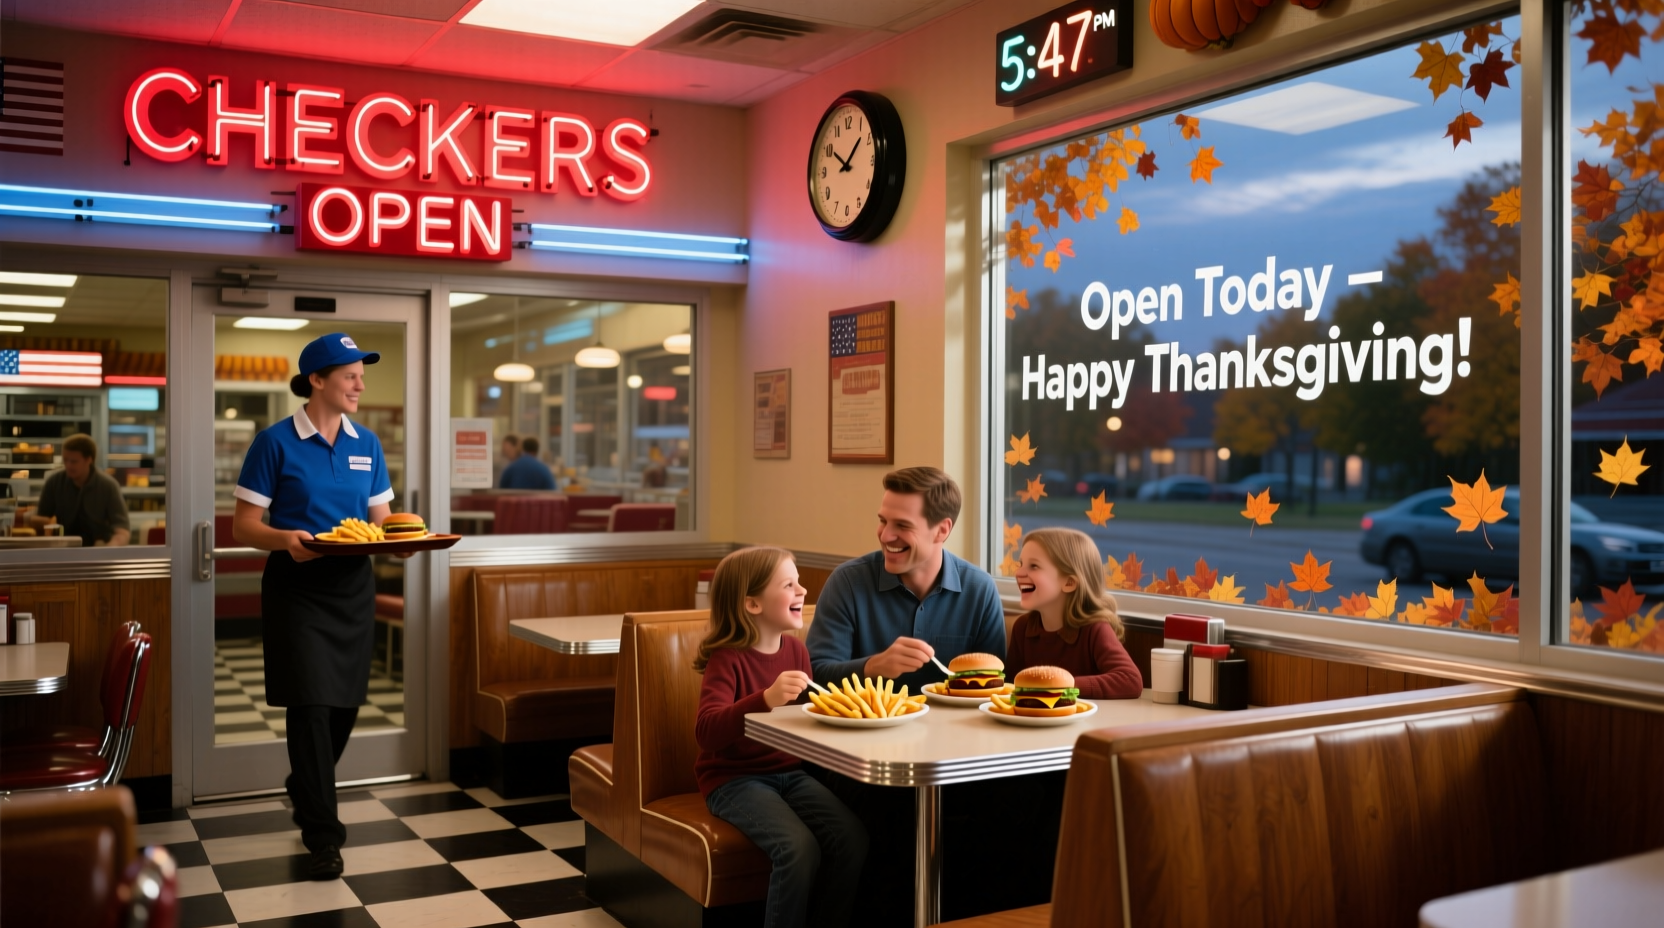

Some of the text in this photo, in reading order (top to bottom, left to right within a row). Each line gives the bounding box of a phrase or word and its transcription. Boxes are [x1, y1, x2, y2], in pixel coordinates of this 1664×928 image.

[1001, 9, 1116, 92] 5:47 PM
[124, 67, 654, 203] CHECKERS
[845, 115, 852, 130] 12
[309, 187, 503, 256] OPEN
[1080, 280, 1184, 341] Open
[1194, 255, 1334, 322] Today
[1022, 316, 1472, 411] Happy Thanksgiving!
